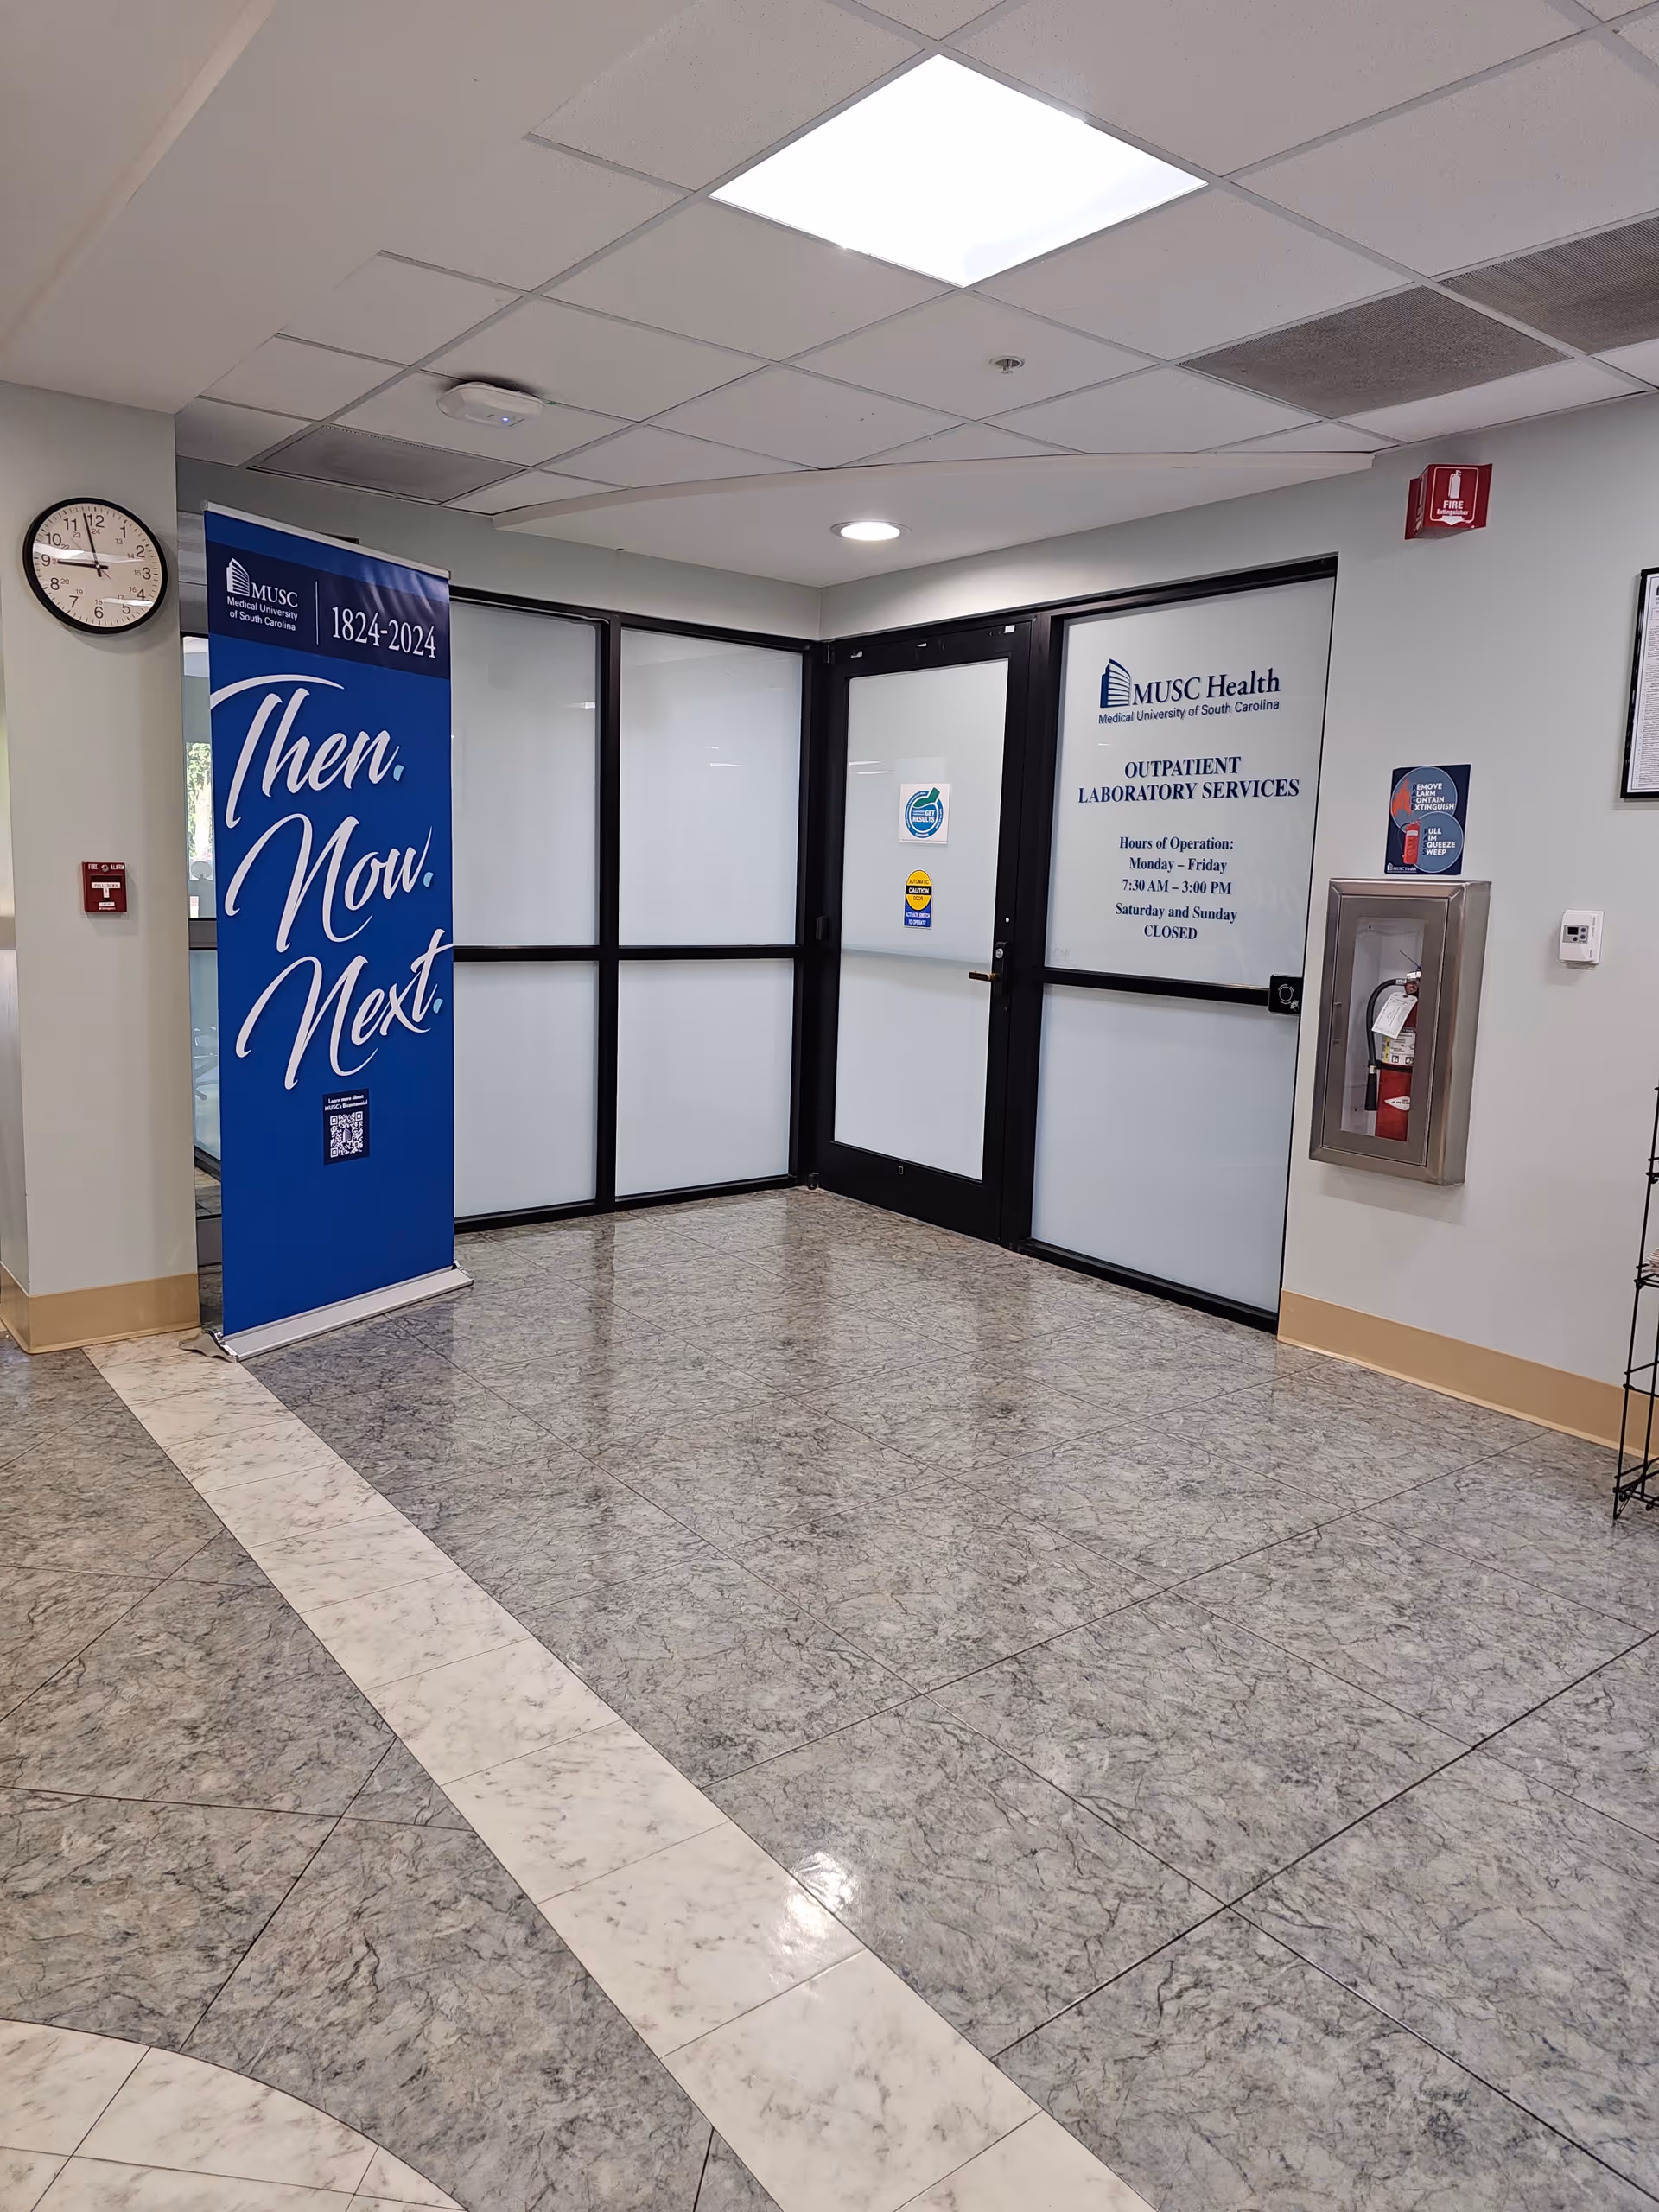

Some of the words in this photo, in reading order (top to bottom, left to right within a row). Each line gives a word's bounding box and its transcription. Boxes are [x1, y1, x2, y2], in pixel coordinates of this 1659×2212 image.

[1443, 499, 1464, 509] FIRE
[63, 518, 78, 531] 11
[87, 514, 105, 528] 12
[45, 533, 61, 546] 10
[120, 526, 126, 538] 1
[136, 545, 145, 558] 2
[41, 554, 50, 567] 9
[142, 567, 151, 580] 3
[50, 578, 60, 590] 8
[69, 595, 79, 607] 7
[137, 588, 146, 601] 4
[251, 582, 298, 607] MUSC
[94, 607, 104, 619] 6
[122, 604, 131, 614] 5
[227, 595, 257, 611] Medical
[259, 603, 298, 621] University
[229, 610, 238, 619] of
[239, 611, 263, 624] South
[264, 617, 296, 631] Carolina
[332, 605, 436, 658] 1824-2024
[1132, 677, 1201, 705] MUSC
[1206, 667, 1281, 698] Health
[1098, 711, 1134, 724] Medical
[1136, 707, 1185, 721] University
[1188, 705, 1200, 716] of
[1201, 702, 1231, 715] South
[1235, 699, 1279, 713] Carolina
[210, 674, 404, 829] Then.
[1124, 756, 1241, 778] OUTPATIENT
[1078, 782, 1198, 803] LABORATORY
[1202, 778, 1300, 799] SERVICES
[1119, 836, 1153, 849] Hours
[1155, 836, 1168, 849] of
[1170, 836, 1234, 853] Operation:
[1129, 857, 1174, 873] Monday
[1187, 858, 1227, 874] Friday
[225, 813, 434, 952] Now.
[1122, 879, 1145, 892] 7:30
[1147, 880, 1169, 893] AM
[1181, 880, 1207, 893] 3:00
[1210, 881, 1232, 894] PM
[1116, 902, 1165, 919] Saturday
[1168, 906, 1190, 918] and
[1192, 906, 1237, 924] Sunday
[1144, 925, 1198, 939] CLOSED
[236, 928, 454, 1090] Next.
